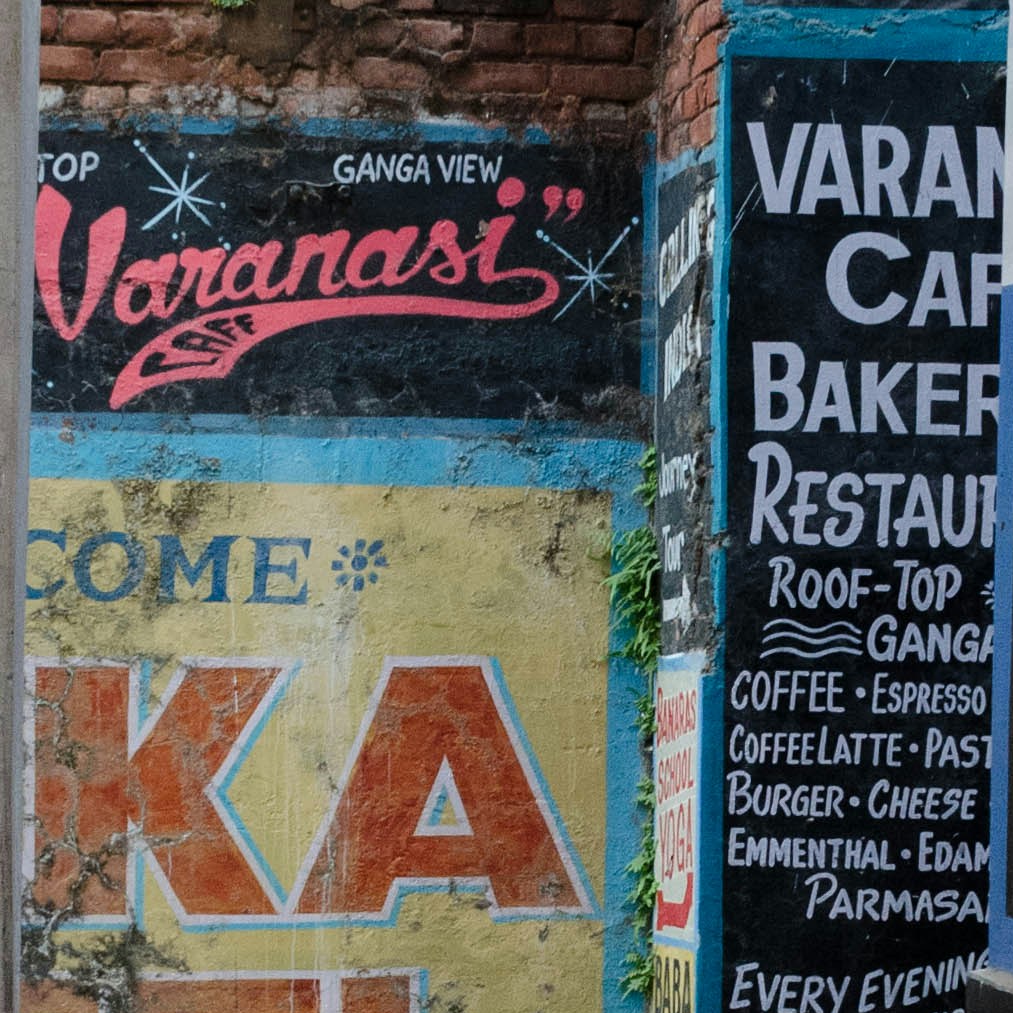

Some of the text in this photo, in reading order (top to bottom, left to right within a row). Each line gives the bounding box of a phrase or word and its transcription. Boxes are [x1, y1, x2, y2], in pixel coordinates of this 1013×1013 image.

[37, 151, 100, 183] TOP
[333, 153, 502, 185] GANGA VIEW
[746, 121, 1005, 219] VARAN
[826, 232, 1002, 327] CAF
[752, 341, 1000, 436] BAKER
[25, 530, 311, 605] COME
[768, 556, 963, 612] ROOF-TOP
[656, 687, 697, 747] BANARAS
[731, 670, 986, 716] COFFEE ESPRESSO
[23, 655, 602, 931] KA
[658, 747, 694, 805] SCHOOL
[728, 770, 977, 820] BURGER CHEESE
[658, 799, 693, 883] YOGA
[728, 827, 896, 872] EMMENTHAL
[805, 873, 989, 923] PARMASA
